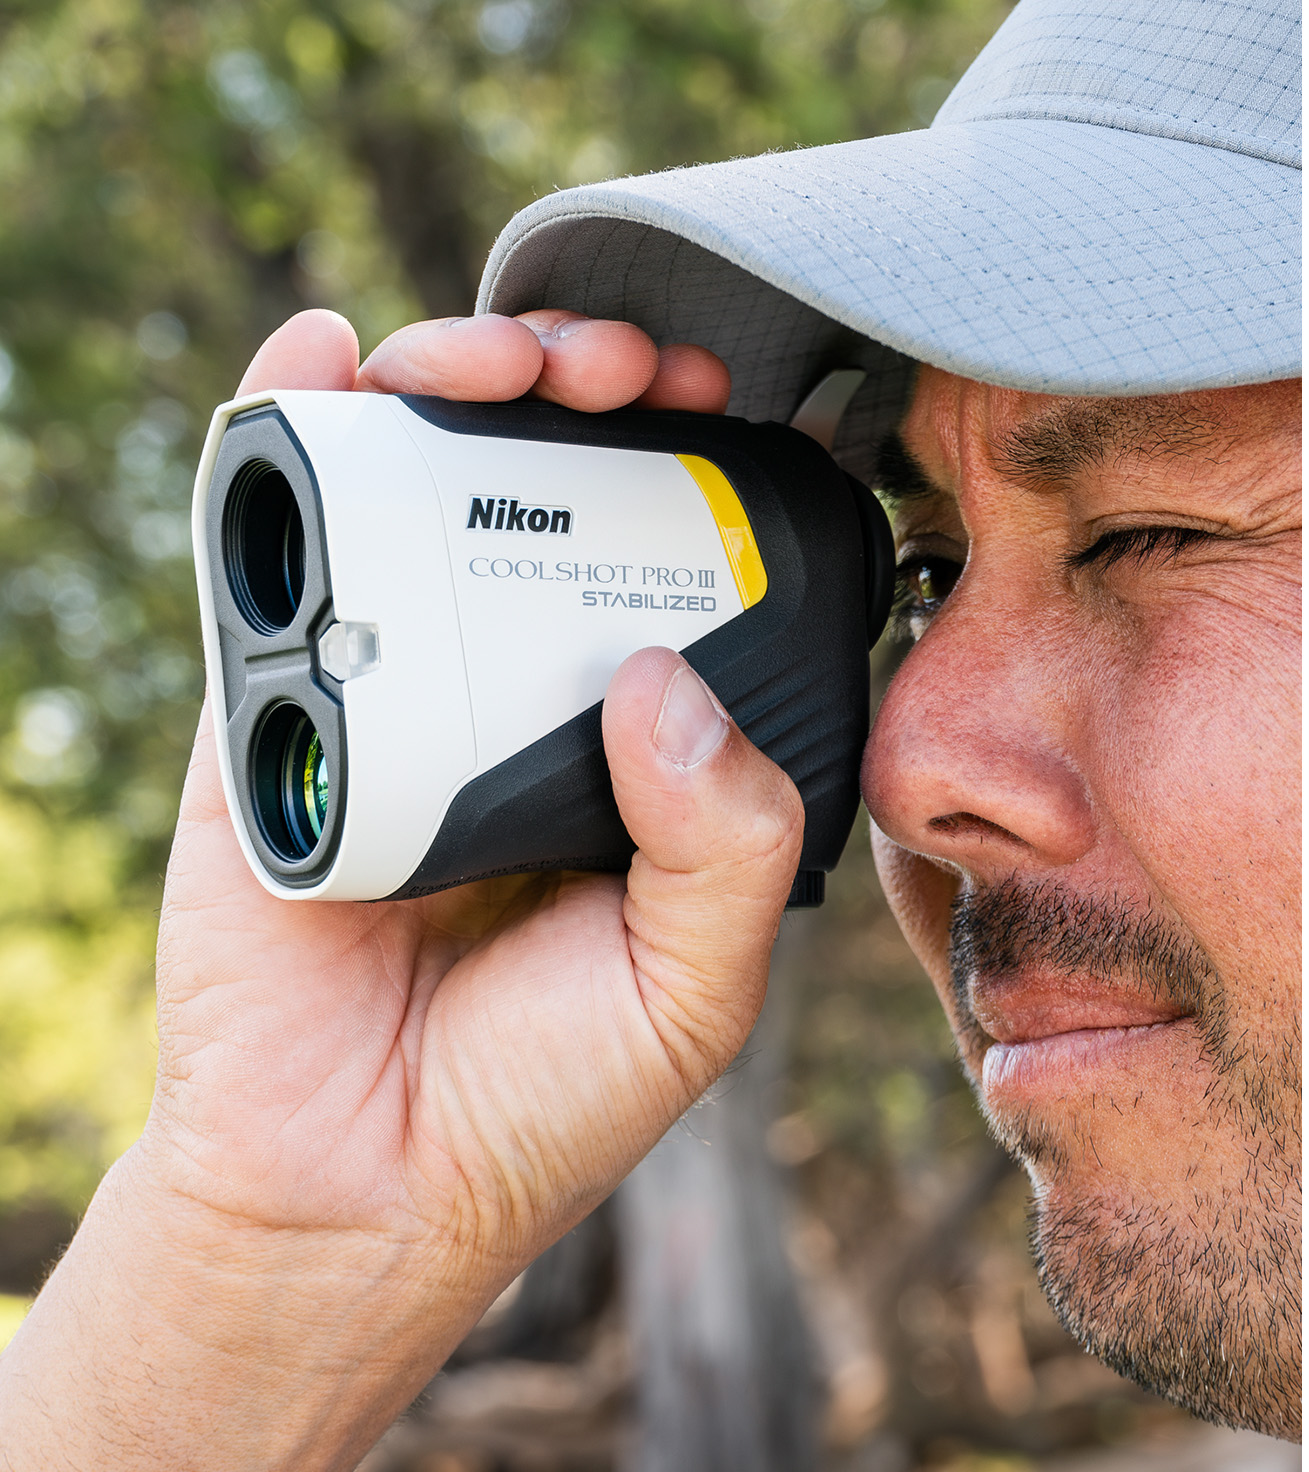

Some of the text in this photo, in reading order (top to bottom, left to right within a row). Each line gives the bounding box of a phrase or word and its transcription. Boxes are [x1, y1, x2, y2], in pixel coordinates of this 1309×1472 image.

[468, 497, 572, 534] Nikon
[469, 557, 634, 584] COOLSHOT
[582, 591, 716, 612] STABILIZED
